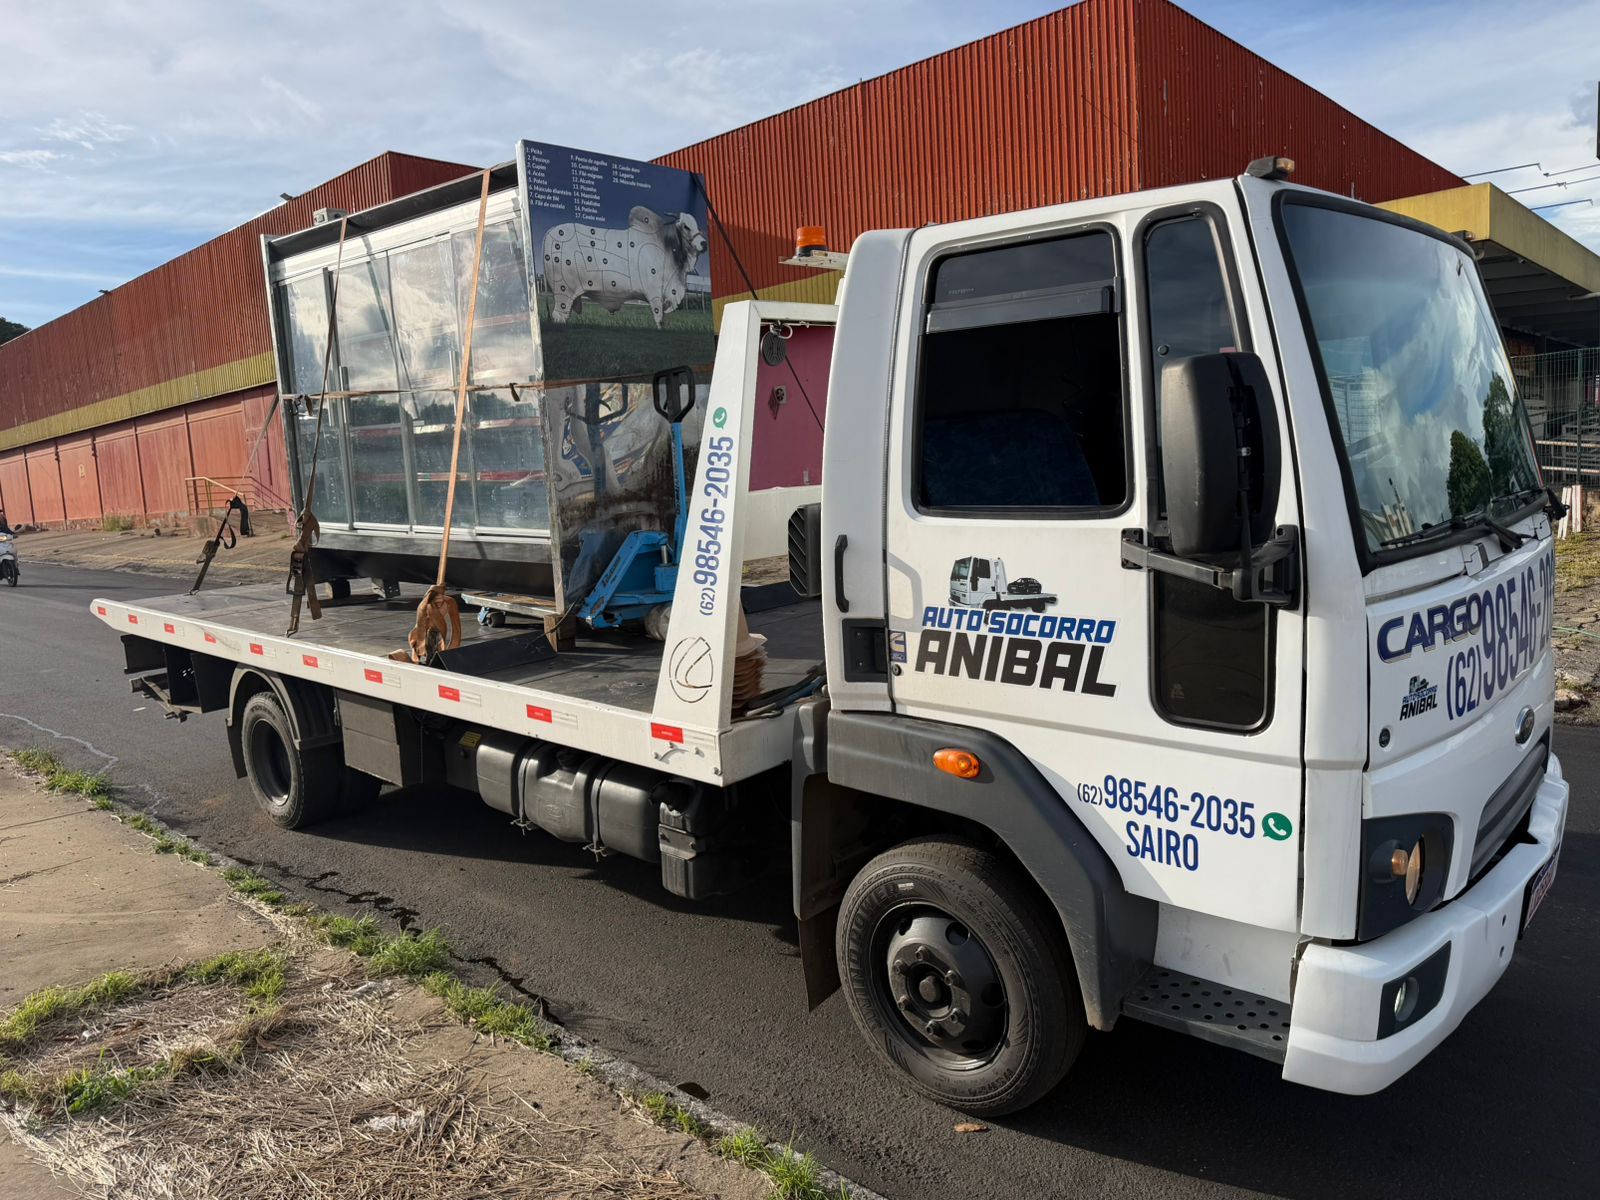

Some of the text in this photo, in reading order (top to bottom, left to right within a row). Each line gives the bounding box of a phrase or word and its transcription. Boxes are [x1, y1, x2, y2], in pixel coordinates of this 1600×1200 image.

[922, 606, 1117, 644] AUTO SOCORRO
[1377, 592, 1482, 664] CARGO
[914, 629, 1117, 697] ANIBAL
[1399, 693, 1438, 721] ANIBAL
[1126, 820, 1199, 872] SAIRO
